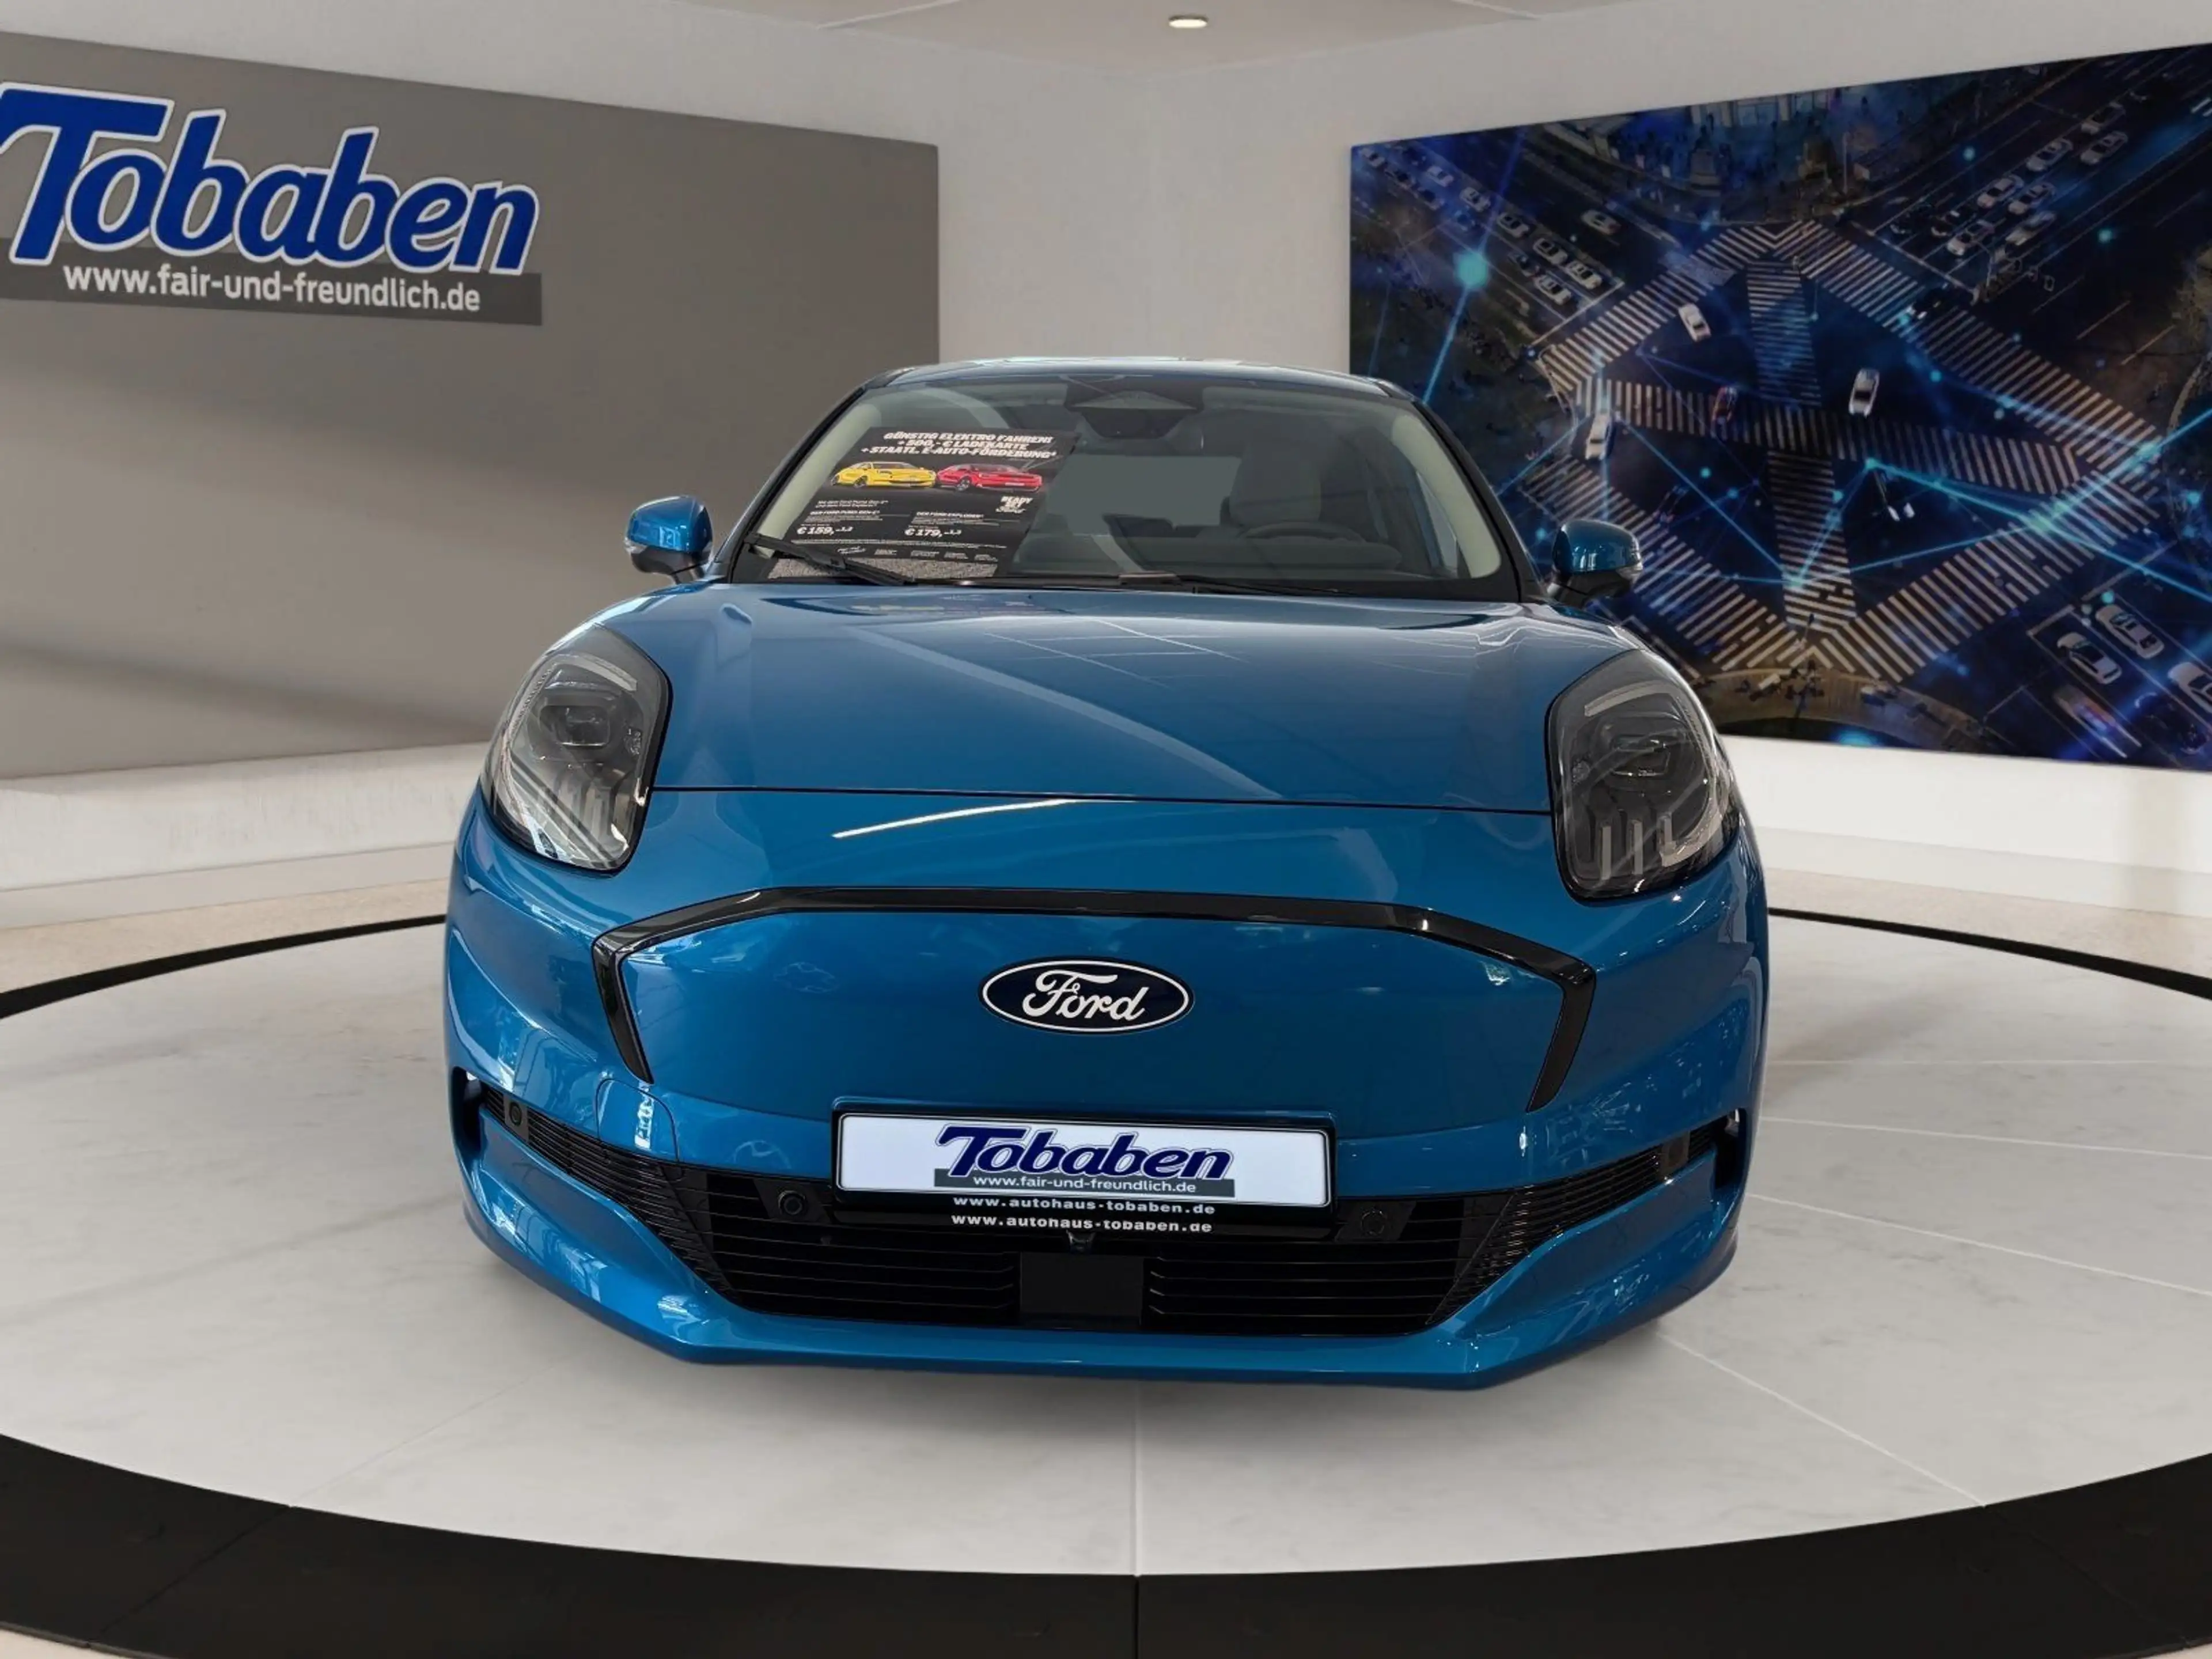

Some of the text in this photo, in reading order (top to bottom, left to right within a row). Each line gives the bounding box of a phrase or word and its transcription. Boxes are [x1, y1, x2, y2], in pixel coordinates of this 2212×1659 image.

[0, 82, 539, 275] Tobaben
[63, 263, 481, 312] www.fair-und-freundlich.de
[883, 431, 939, 440] GÜNSTIG
[938, 433, 996, 441] ELEKTRO
[952, 441, 1030, 450] LADEKARTE
[869, 446, 920, 454] STAATL.
[1022, 969, 1147, 1022] Ford
[935, 1123, 1234, 1180] Tobaben
[973, 1175, 1196, 1192] www.fair-und-freundlich.de
[953, 1195, 1215, 1215] www.autohaus-tobaben.de
